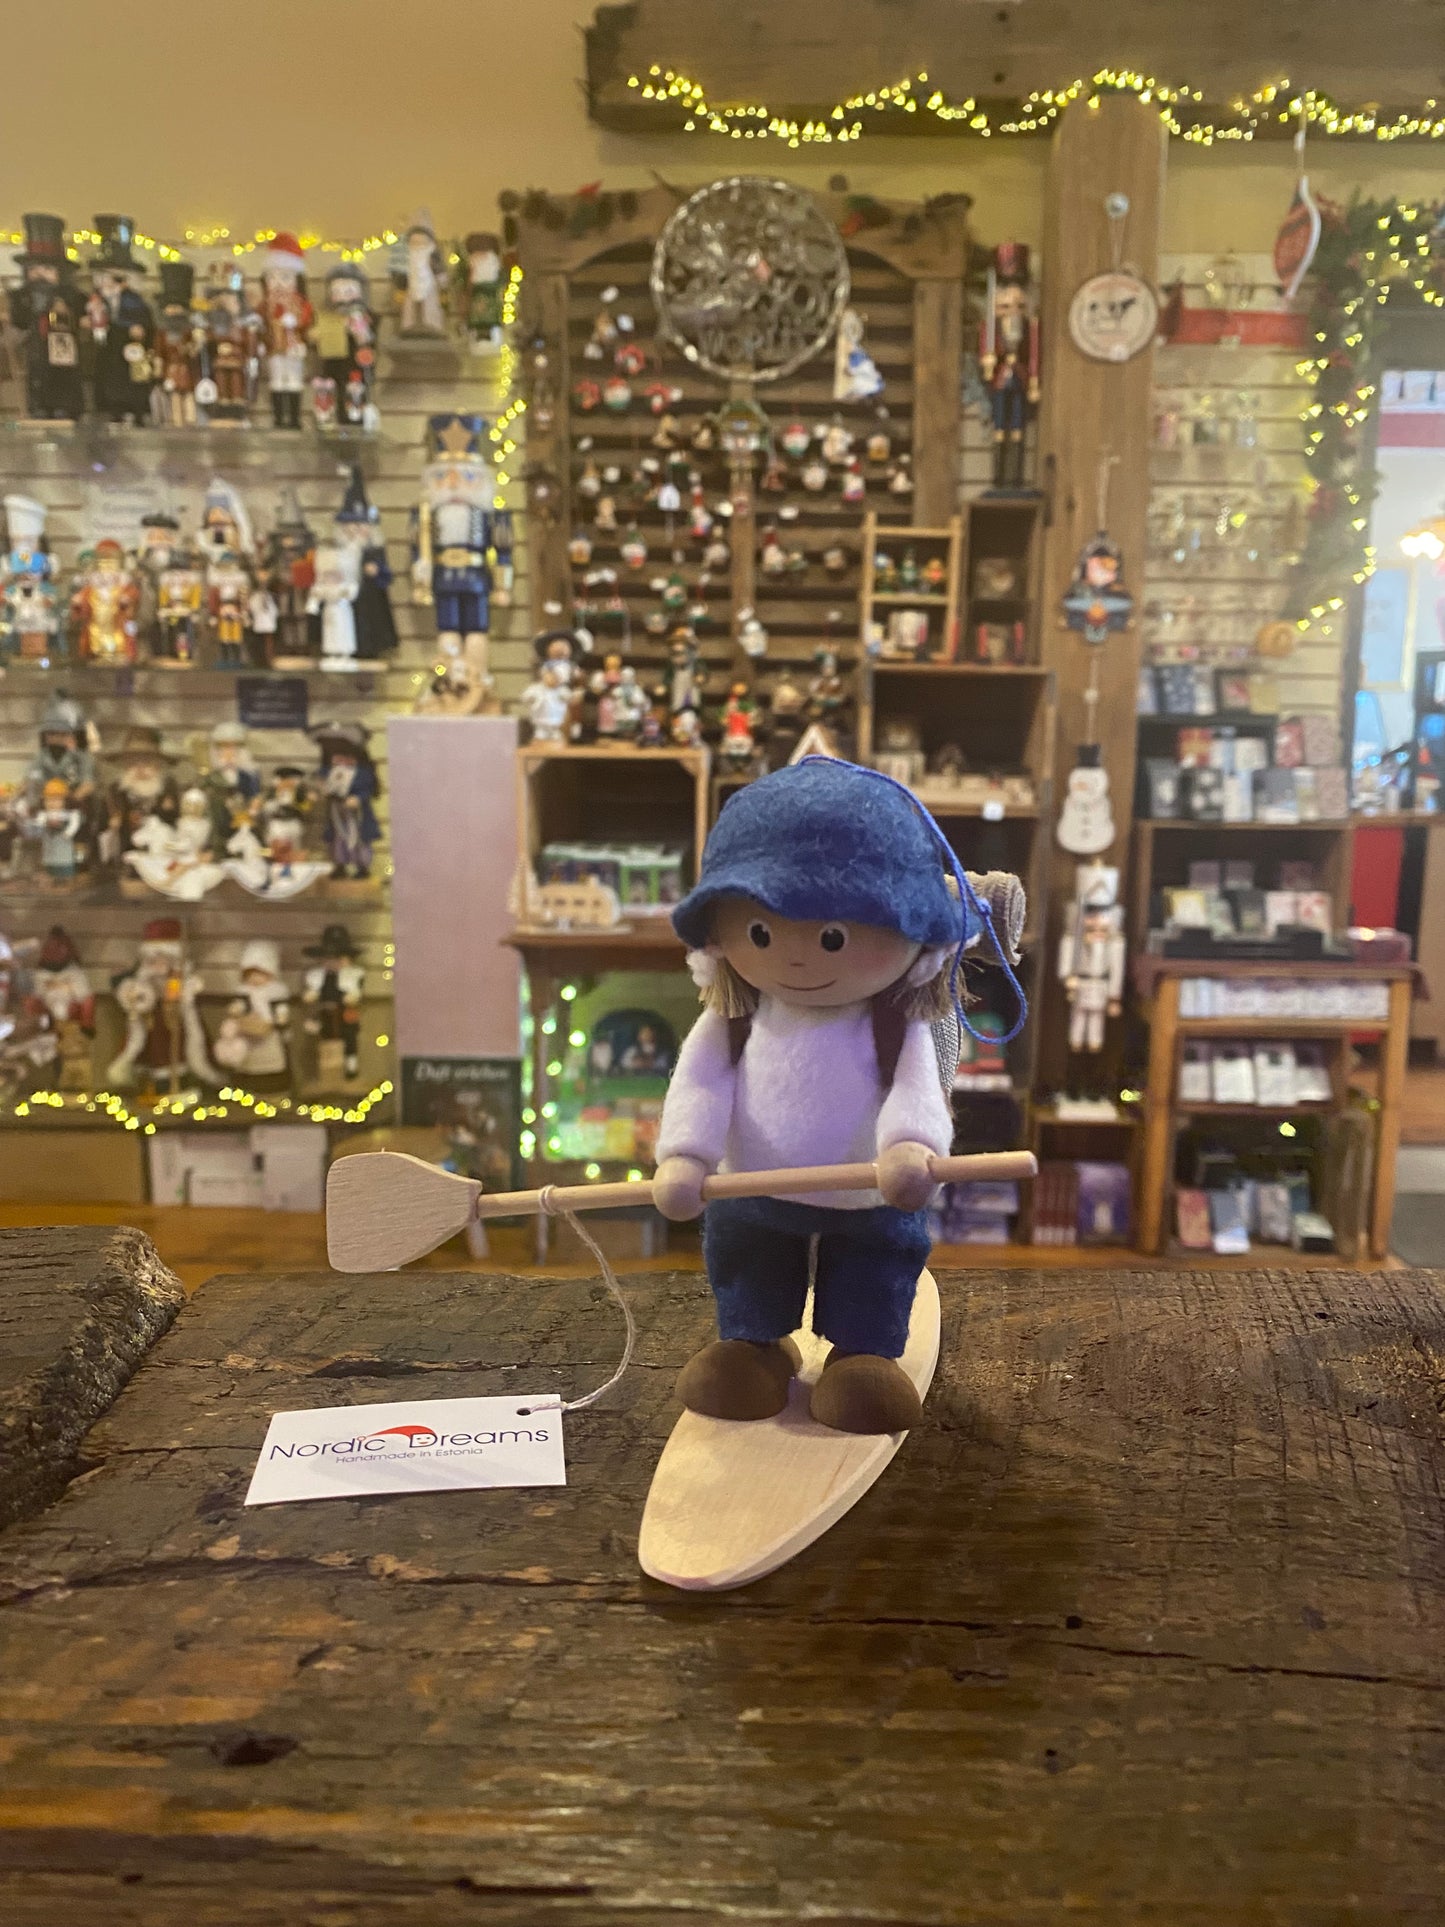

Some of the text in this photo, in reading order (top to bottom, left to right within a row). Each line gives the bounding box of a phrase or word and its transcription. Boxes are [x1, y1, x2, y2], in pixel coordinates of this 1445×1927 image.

[270, 1430, 549, 1460] Nordic Dreams
[336, 1452, 416, 1463] Handmade
[436, 1447, 483, 1457] Estonia
